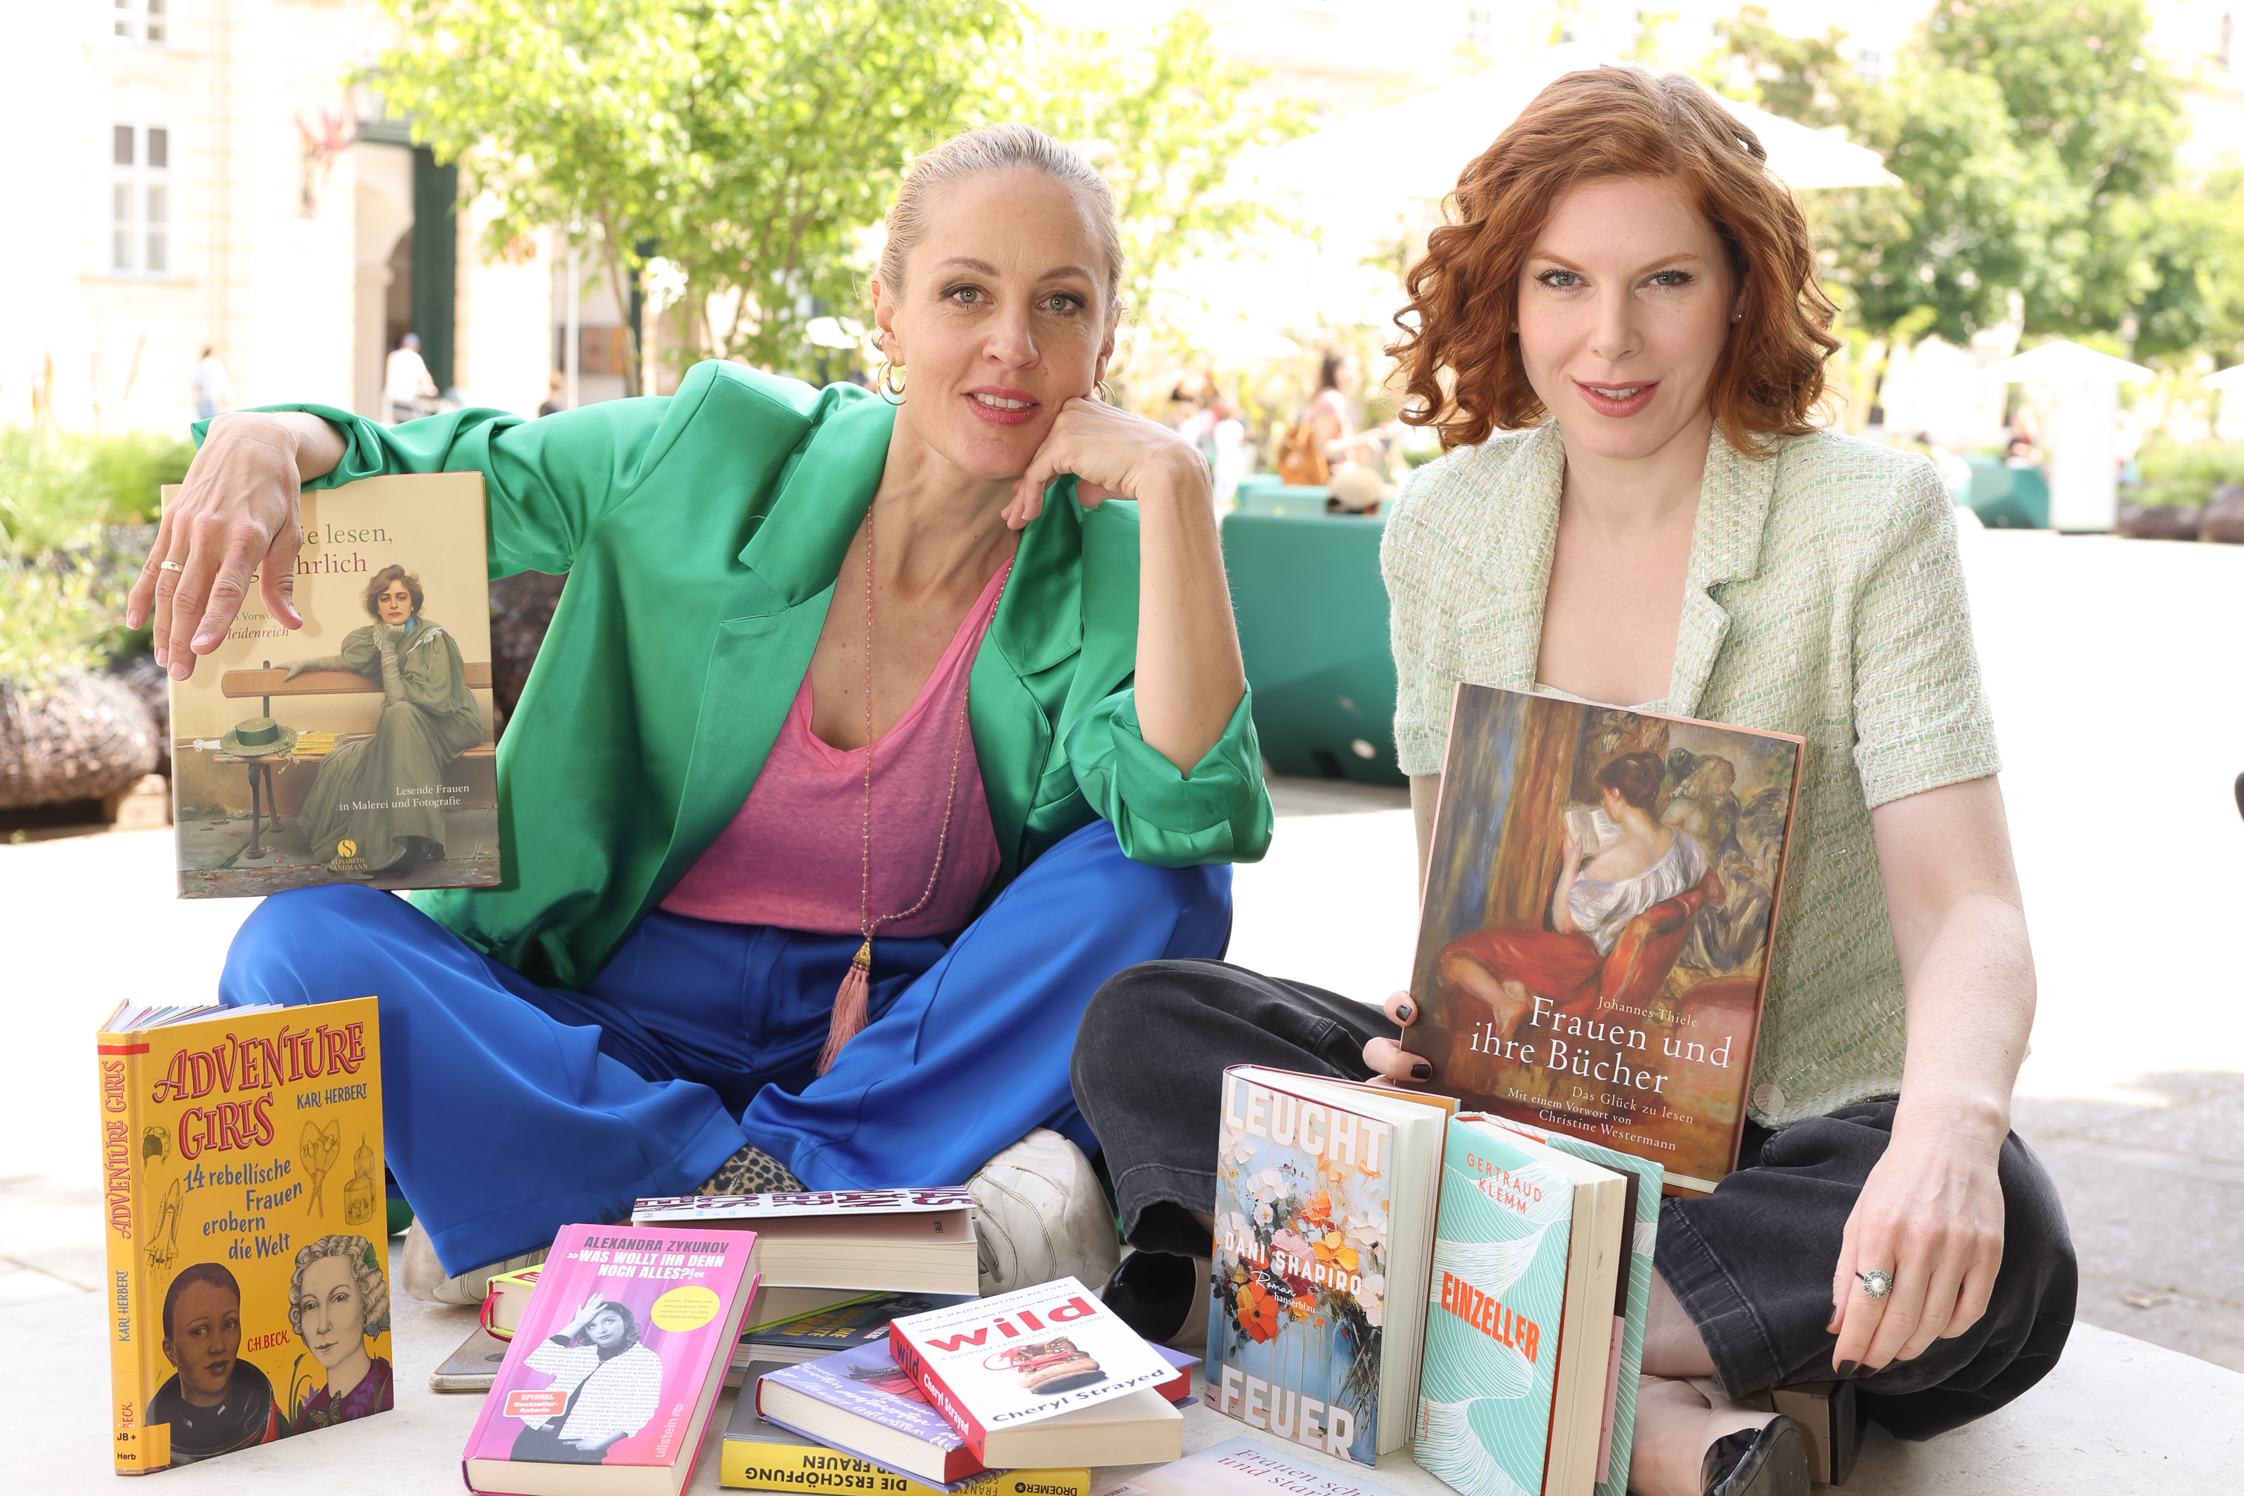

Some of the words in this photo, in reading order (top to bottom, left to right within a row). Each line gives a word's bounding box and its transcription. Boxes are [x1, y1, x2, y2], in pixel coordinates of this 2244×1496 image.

[301, 525, 319, 545] ie
[325, 524, 393, 544] lesen,
[242, 612, 272, 620] Vorwo
[339, 802, 350, 811] in
[352, 800, 389, 810] Malerei
[392, 798, 410, 808] und
[413, 796, 461, 809] Fotografie
[396, 785, 434, 796] Lesende
[436, 784, 470, 794] Frauen
[1597, 996, 1654, 1019] Johannes
[1658, 1008, 1698, 1028] Thiele
[1529, 995, 1647, 1051] Frauen
[1662, 1035, 1732, 1068] und
[152, 1021, 366, 1104] ADVENTURE
[1470, 1021, 1536, 1064] ihre
[1546, 1038, 1669, 1094] Bücher
[102, 1060, 128, 1113] GIRLS
[178, 1092, 275, 1160] GIRLS
[296, 1093, 323, 1110] KARL
[324, 1083, 368, 1105] HERBERT
[1508, 1087, 1528, 1101] Mit
[1531, 1095, 1562, 1110] einem
[1566, 1100, 1609, 1120] Vorwort
[1612, 1116, 1632, 1126] von
[1572, 1086, 1596, 1102] Das
[1600, 1092, 1638, 1112] Glück
[1642, 1104, 1657, 1116] zu
[1662, 1106, 1694, 1124] lesen
[1225, 1075, 1390, 1172] LEUCHT
[1538, 1109, 1597, 1133] Christine
[1600, 1123, 1676, 1152] Westermann
[104, 1119, 132, 1240] ADVENTURE
[183, 1162, 206, 1194] 14
[209, 1158, 292, 1187] rebellische
[1466, 1152, 1542, 1202] GERTRAUD
[245, 1181, 303, 1212] Frauen
[1478, 1177, 1526, 1215] KLEMM
[202, 1210, 266, 1236] erobern
[228, 1237, 252, 1260] die
[254, 1232, 290, 1260] Welt
[584, 1236, 664, 1252] ALEXANDRA
[666, 1240, 730, 1254] ZYKUNOV
[612, 1252, 660, 1266] WOLLT
[660, 1254, 686, 1267] IHR
[688, 1255, 726, 1268] DENN
[597, 1265, 638, 1278] NOCH
[1224, 1230, 1266, 1264] DANI
[1275, 1250, 1362, 1296] SHAPIRO
[115, 1270, 128, 1315] HERBERT
[946, 1306, 980, 1318] MAJOR
[983, 1295, 1024, 1308] MOTION
[1026, 1283, 1070, 1298] PICTURE
[1274, 1292, 1316, 1314] hanserblau
[118, 1316, 130, 1342] KARL
[923, 1296, 1098, 1352] wild
[1440, 1271, 1540, 1365] EINZELLER
[247, 1330, 290, 1353] C.H.BECK
[949, 1346, 994, 1360] JOURNEY
[997, 1338, 1024, 1349] FROM
[1026, 1330, 1051, 1341] LOST
[1069, 1315, 1106, 1328] FOUND
[896, 1340, 920, 1382] wild
[924, 1372, 944, 1406] Cheryl
[944, 1397, 970, 1436] Strayed
[992, 1397, 1070, 1422] Cheryl
[1075, 1369, 1165, 1401] Strayed
[1220, 1364, 1355, 1460] FEUER
[116, 1433, 129, 1441] JB
[655, 1418, 679, 1458] ullstein
[116, 1452, 136, 1460] Herb
[803, 1455, 871, 1473] FRAUEN
[1217, 1457, 1271, 1477] und
[1234, 1449, 1317, 1482] Frauen
[744, 1466, 874, 1489] ERSCHÖPFUNG
[880, 1478, 908, 1492] DIE
[1026, 1484, 1078, 1496] DROEMER
